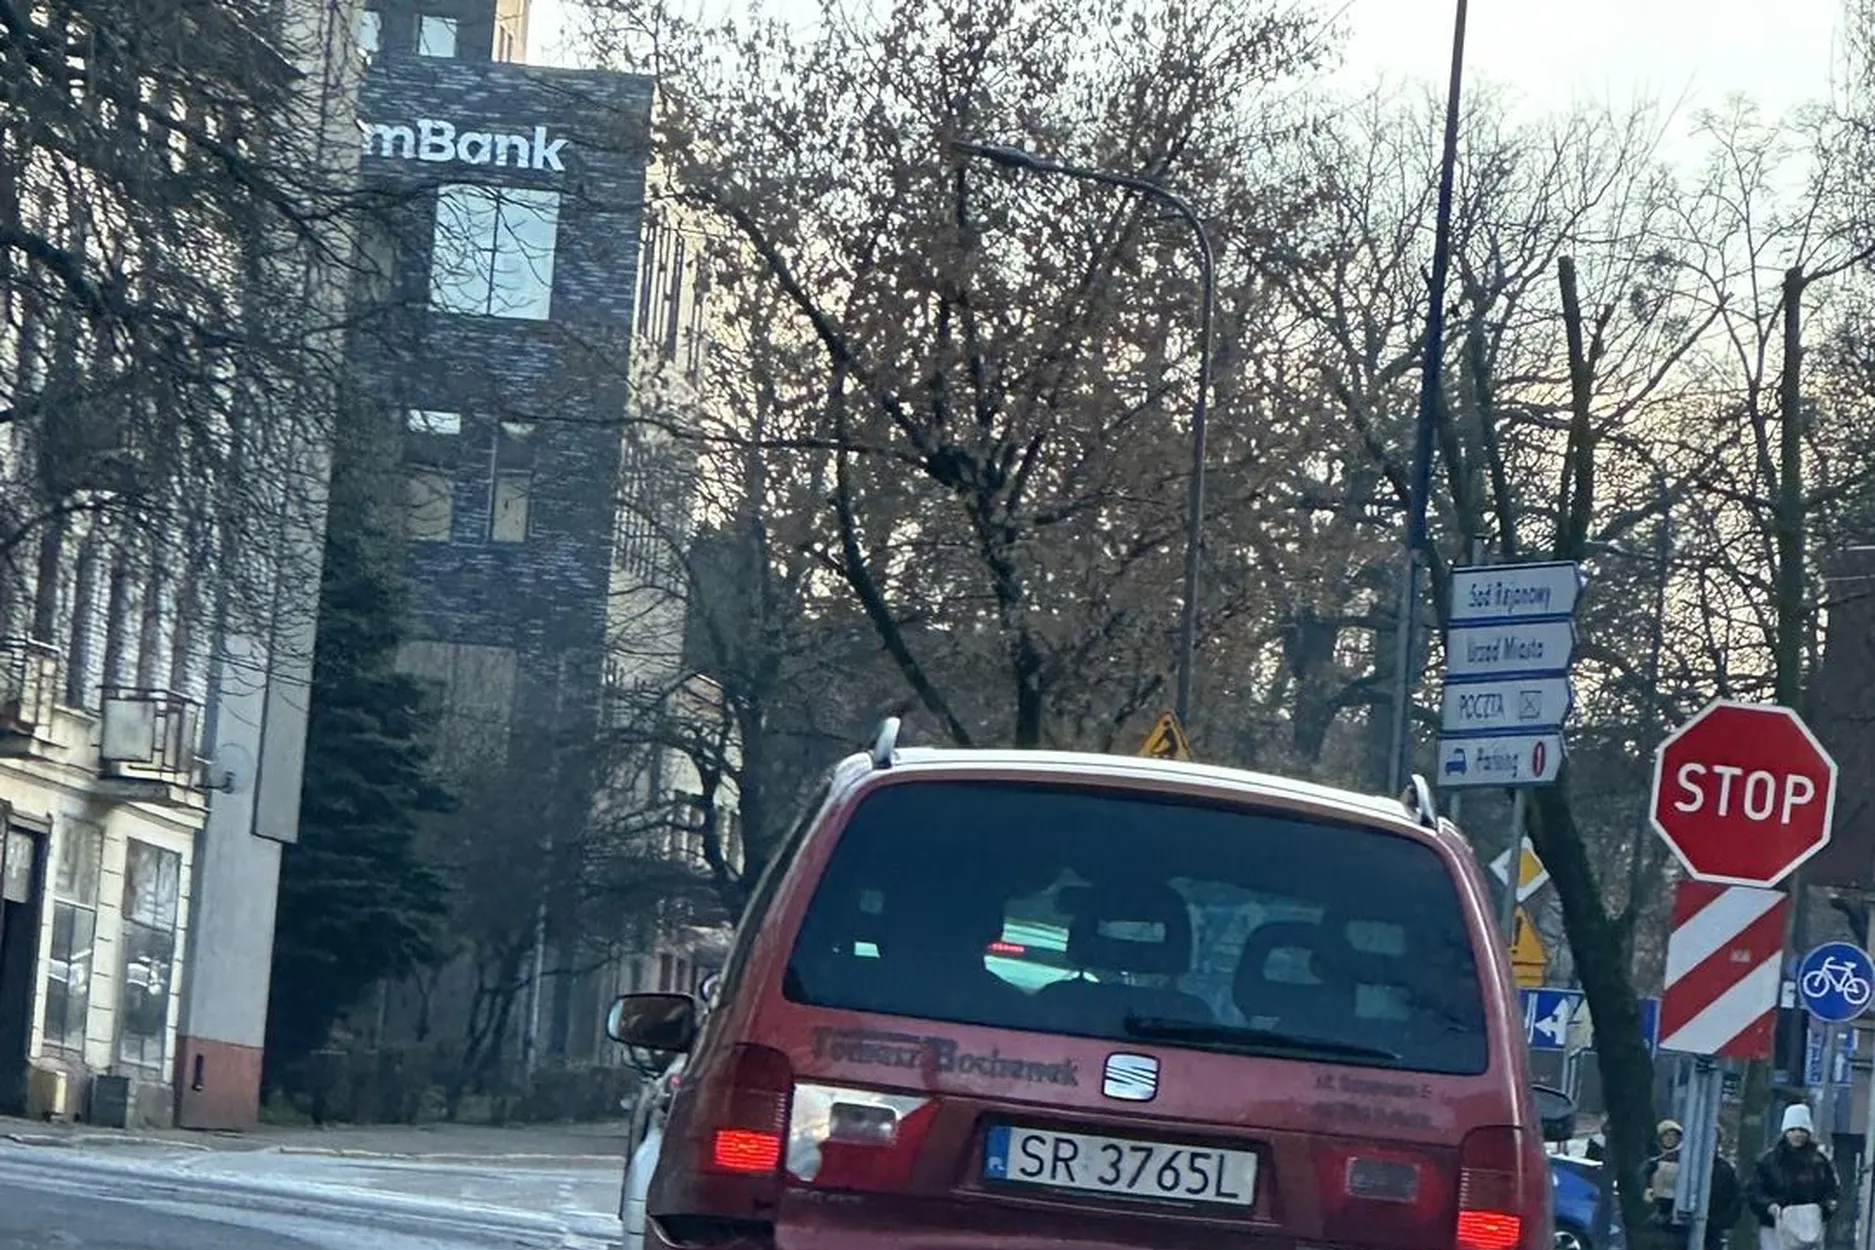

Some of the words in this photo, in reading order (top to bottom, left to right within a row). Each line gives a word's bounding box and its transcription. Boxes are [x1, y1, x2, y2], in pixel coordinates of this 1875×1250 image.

[361, 118, 568, 172] mBank
[1458, 692, 1506, 721] POCZTA
[1674, 762, 1815, 825] STOP
[1019, 1134, 1078, 1183] SR
[1097, 1142, 1239, 1199] 3765L
